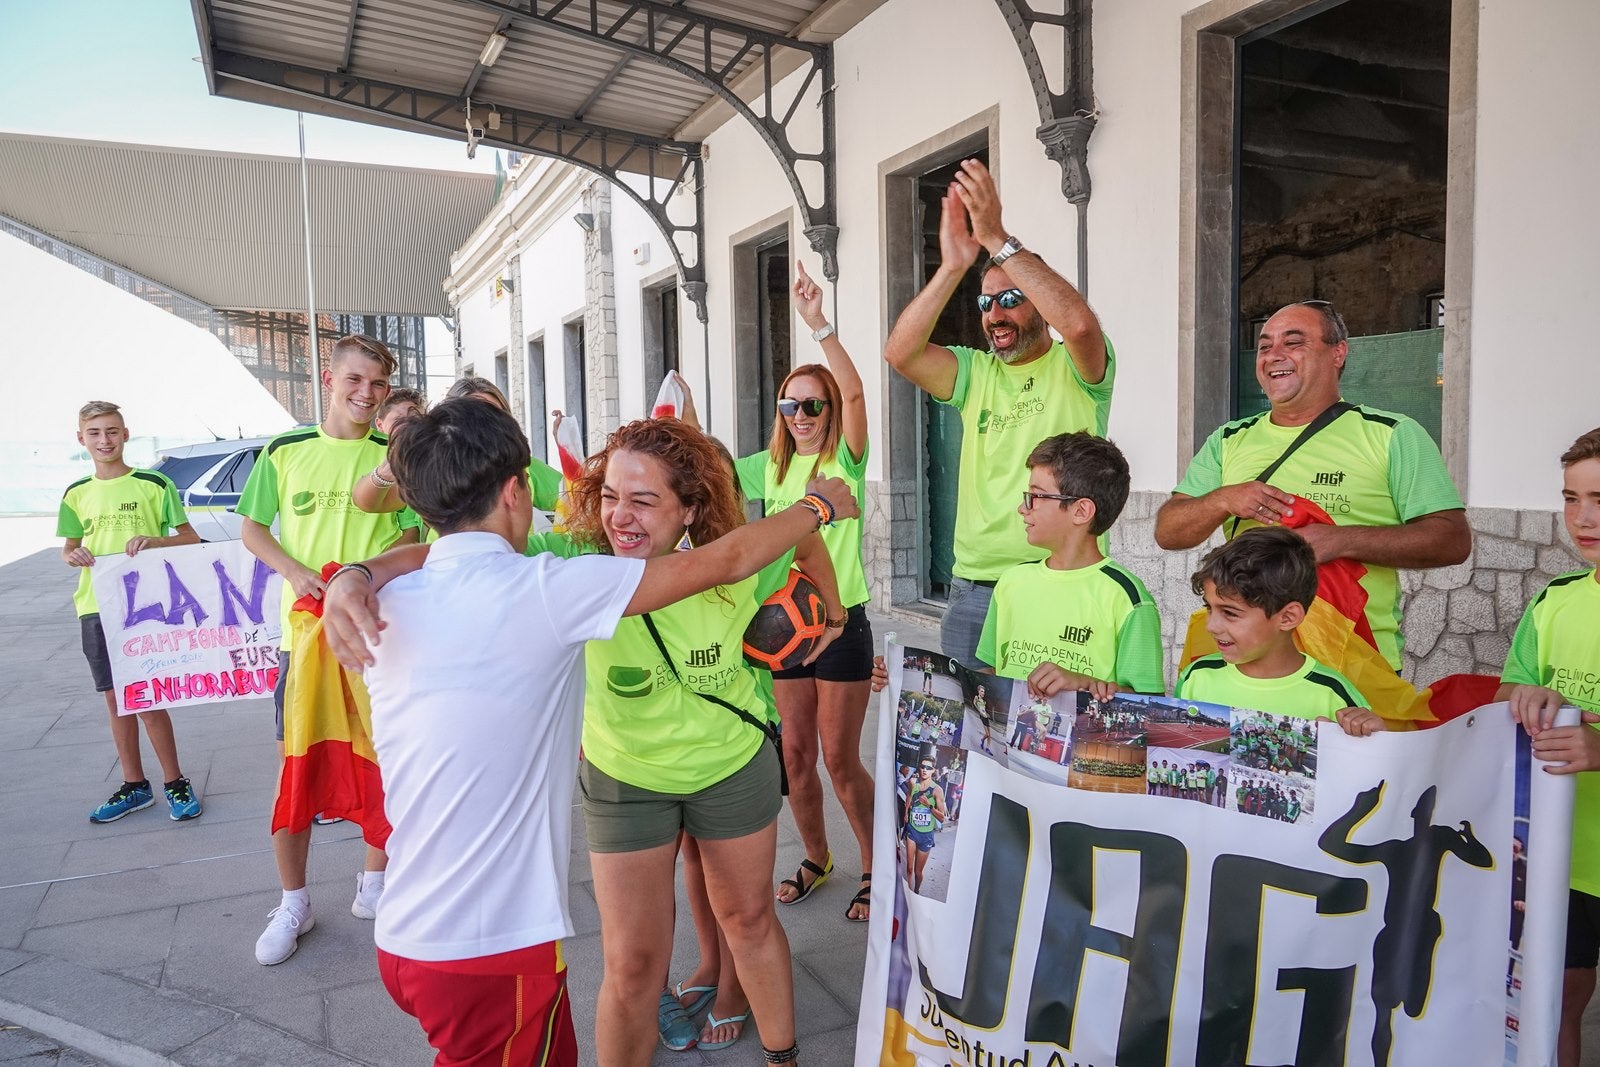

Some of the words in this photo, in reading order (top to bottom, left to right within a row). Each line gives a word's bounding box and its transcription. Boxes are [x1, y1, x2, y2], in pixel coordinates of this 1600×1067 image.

[1305, 493, 1350, 503] DENTAL
[119, 513, 145, 521] DENTAL
[122, 626, 243, 657] CAMPEONA
[244, 630, 259, 644] DE
[1012, 639, 1049, 655] CLÍNICA
[1051, 647, 1094, 667] DENTAL
[688, 663, 739, 684] DENTAL
